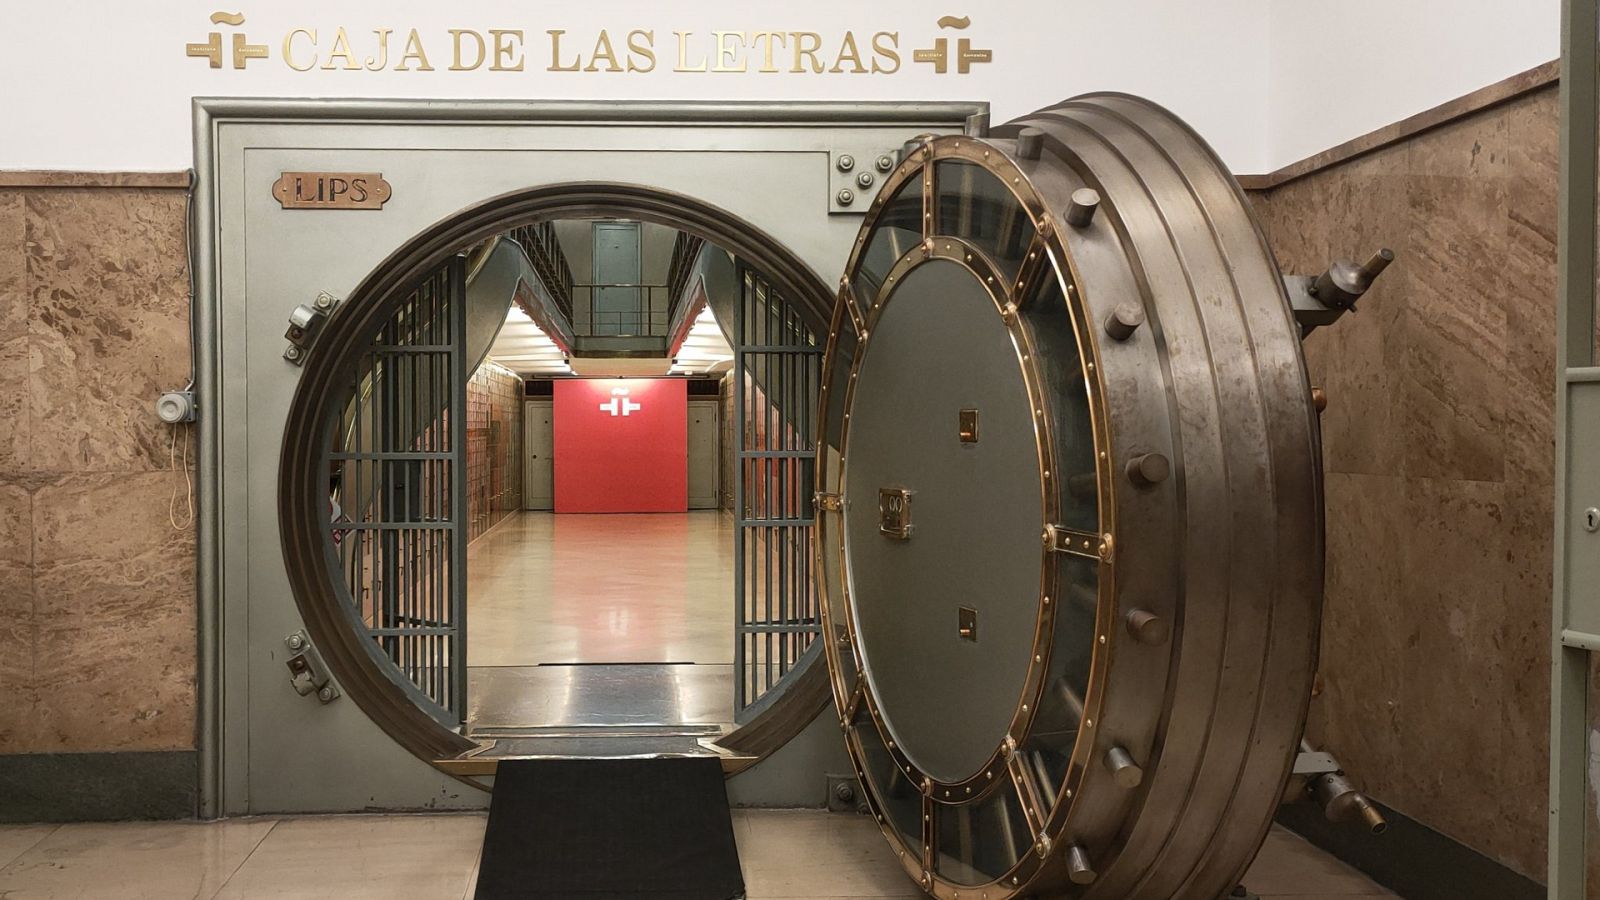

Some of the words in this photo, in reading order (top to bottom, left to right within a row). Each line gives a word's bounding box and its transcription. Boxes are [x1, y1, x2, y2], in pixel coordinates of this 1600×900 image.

[281, 26, 435, 71] CAJA
[448, 29, 525, 71] DE
[546, 29, 656, 73] LAS
[672, 30, 901, 74] LETRAS
[295, 177, 369, 203] LIPS
